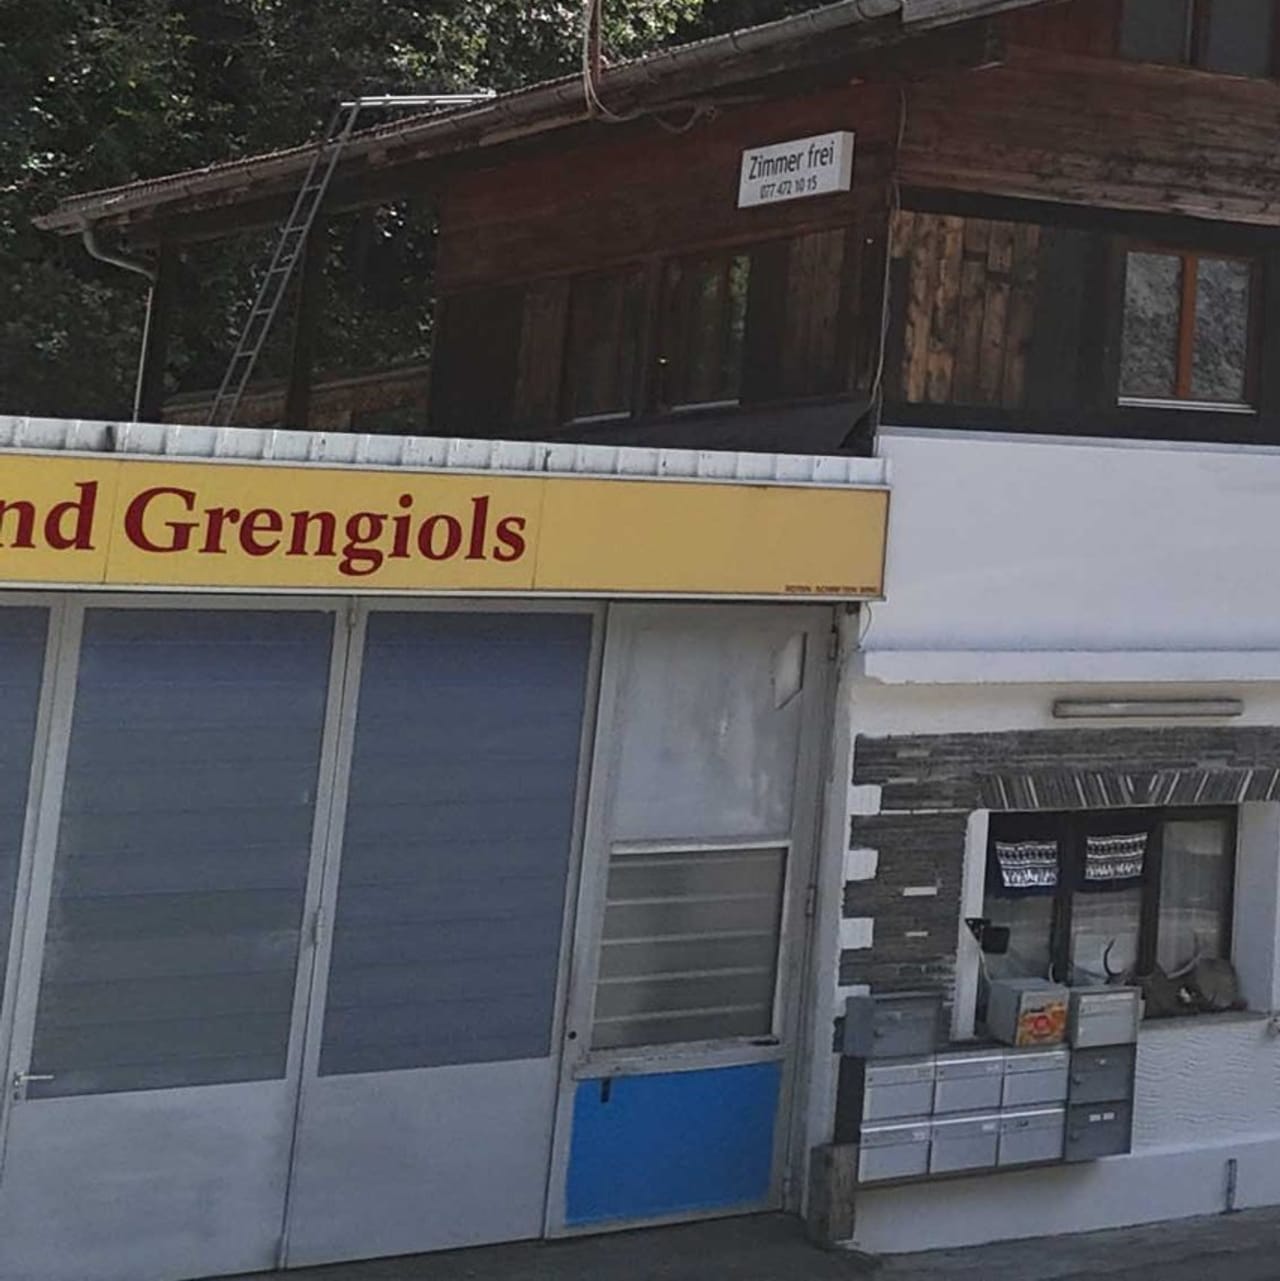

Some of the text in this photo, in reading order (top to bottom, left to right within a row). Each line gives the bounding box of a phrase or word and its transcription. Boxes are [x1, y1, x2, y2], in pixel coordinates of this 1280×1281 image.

[749, 140, 836, 181] Zimmer frei
[124, 485, 527, 578] Grengiols
